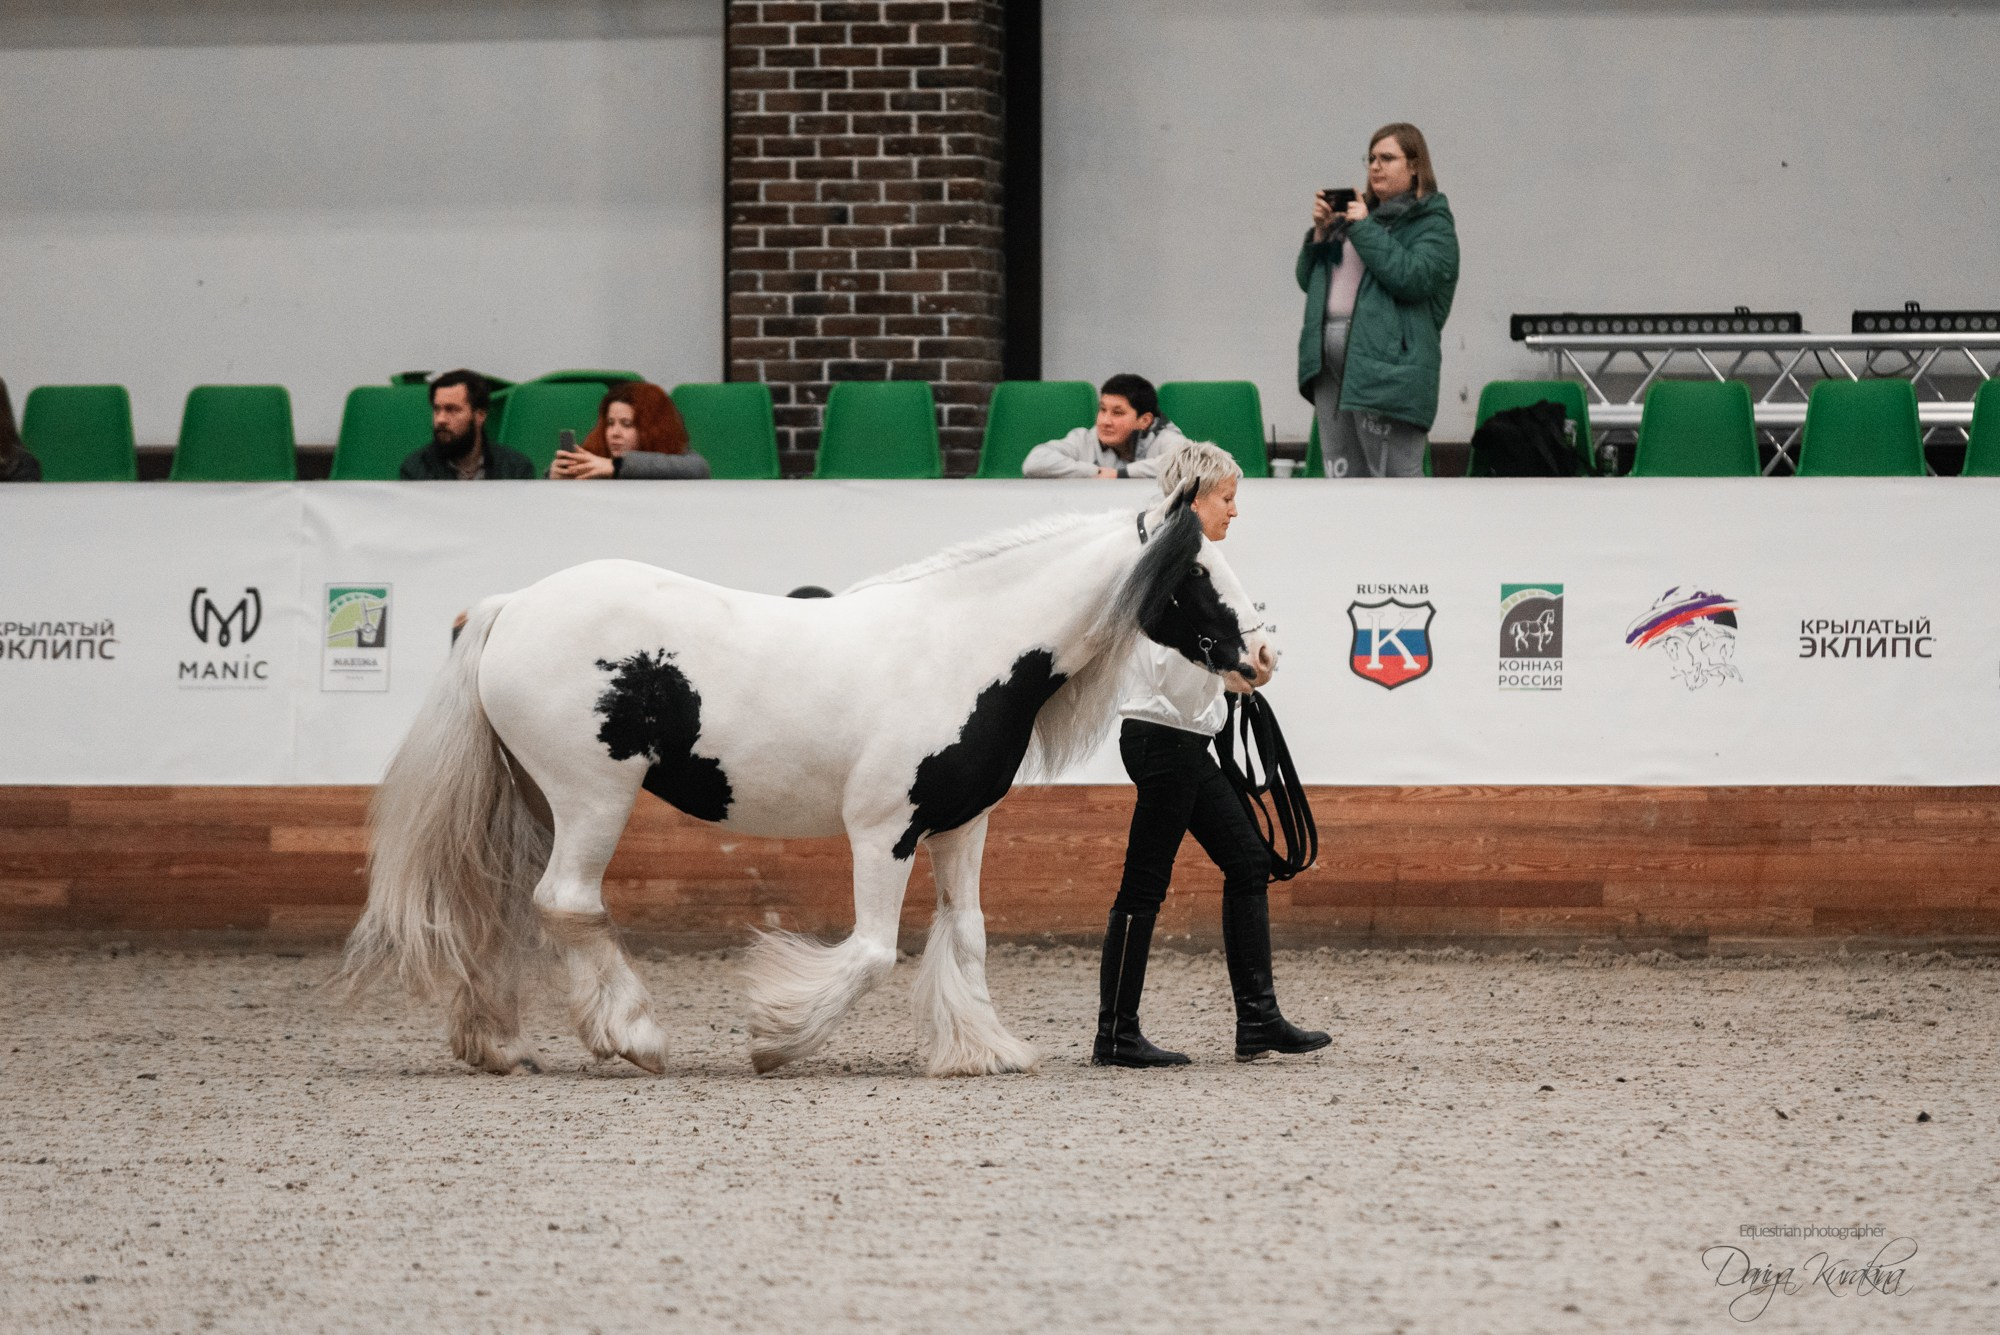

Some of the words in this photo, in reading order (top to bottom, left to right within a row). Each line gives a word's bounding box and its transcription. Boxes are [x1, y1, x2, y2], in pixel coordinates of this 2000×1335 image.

[1356, 584, 1429, 595] RUSKNAB
[0, 619, 115, 637] РЫЛАТЫЙ
[1801, 616, 1931, 635] КРЫЛАТЫЙ
[1799, 636, 1933, 659] ЭКЛИПС
[1499, 660, 1563, 671] КОННАЯ
[1499, 674, 1563, 686] РОССИЯ
